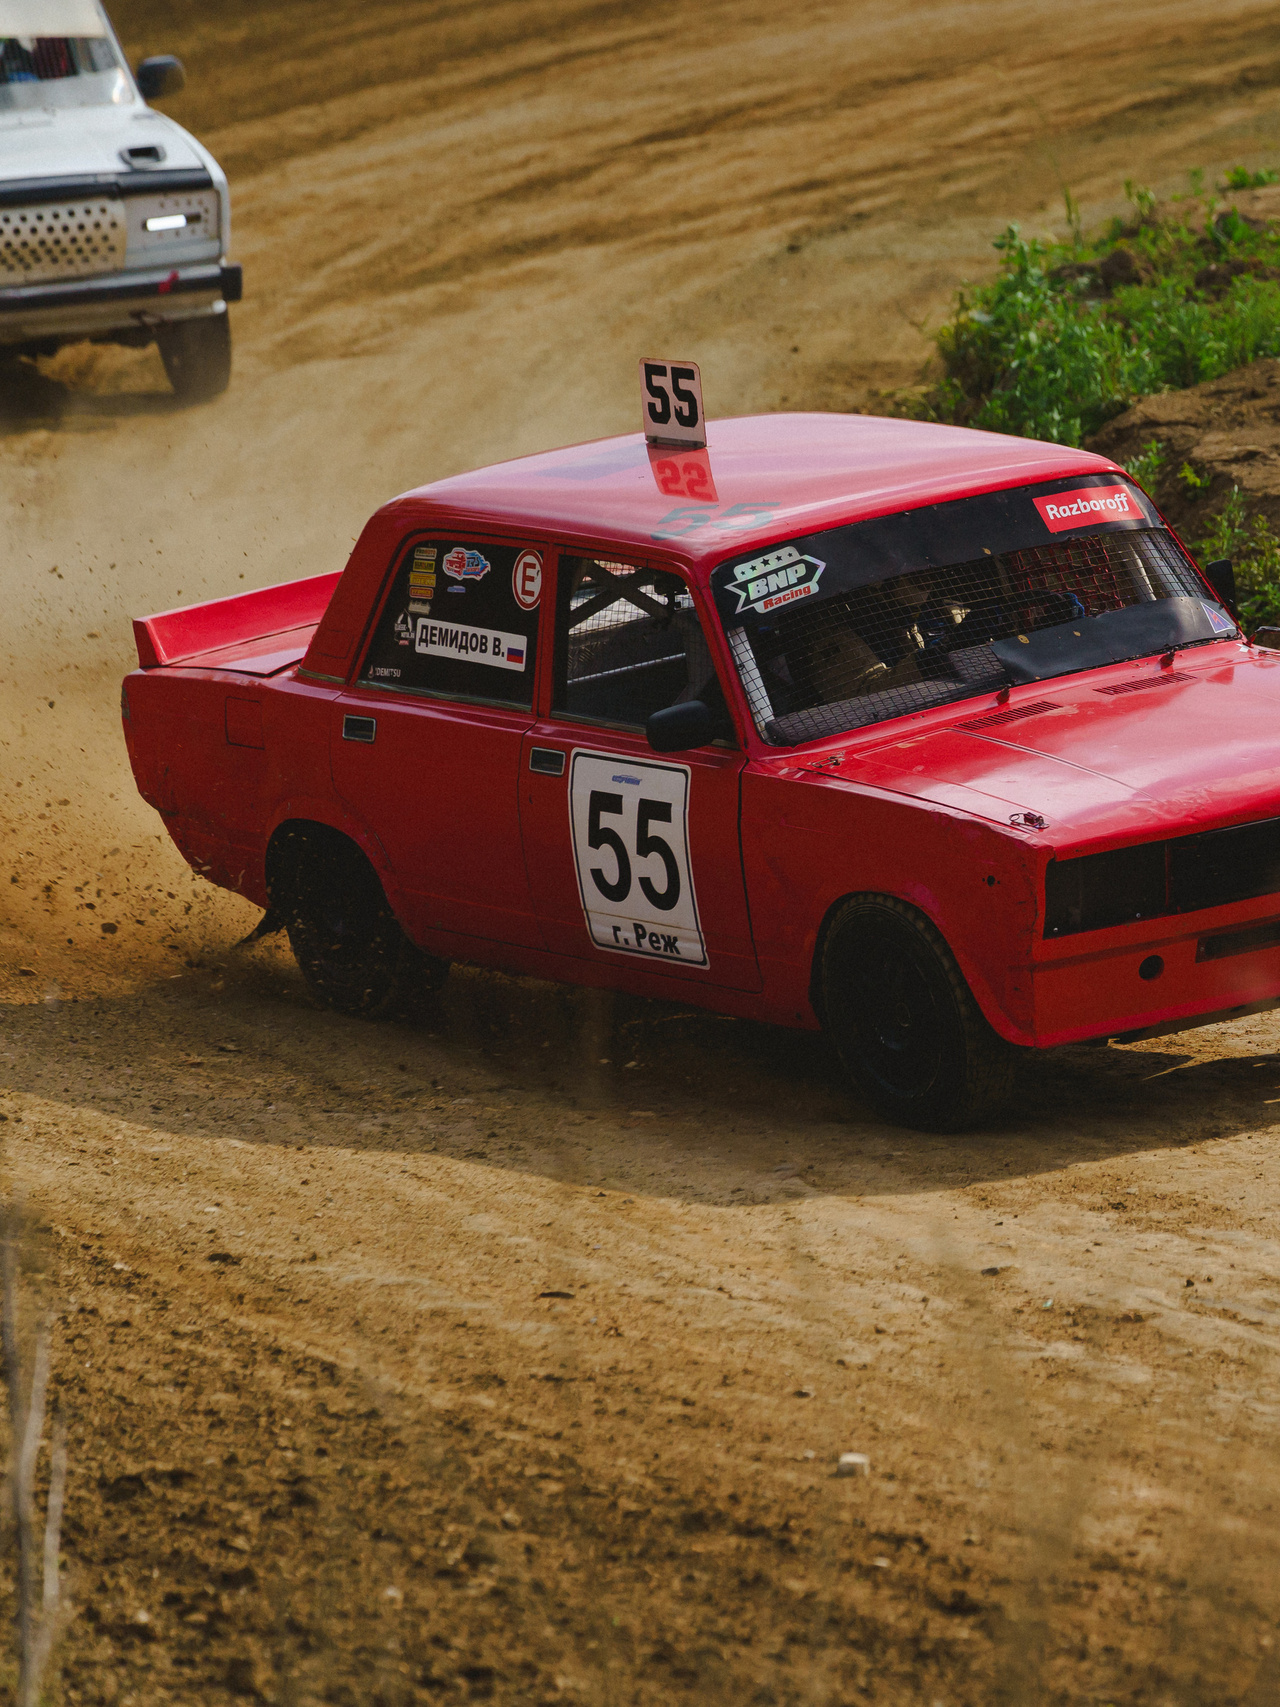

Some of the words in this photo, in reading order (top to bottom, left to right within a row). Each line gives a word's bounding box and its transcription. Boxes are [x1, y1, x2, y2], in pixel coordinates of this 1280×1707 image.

[644, 362, 699, 428] 55
[651, 501, 781, 540] 55
[1045, 492, 1130, 520] Razboroff
[747, 563, 807, 600] BNP
[763, 585, 811, 610] Racing
[418, 624, 489, 655] ДЕМИДОВ
[492, 636, 505, 658] В.
[588, 790, 681, 911] 55
[633, 922, 681, 955] Реж
